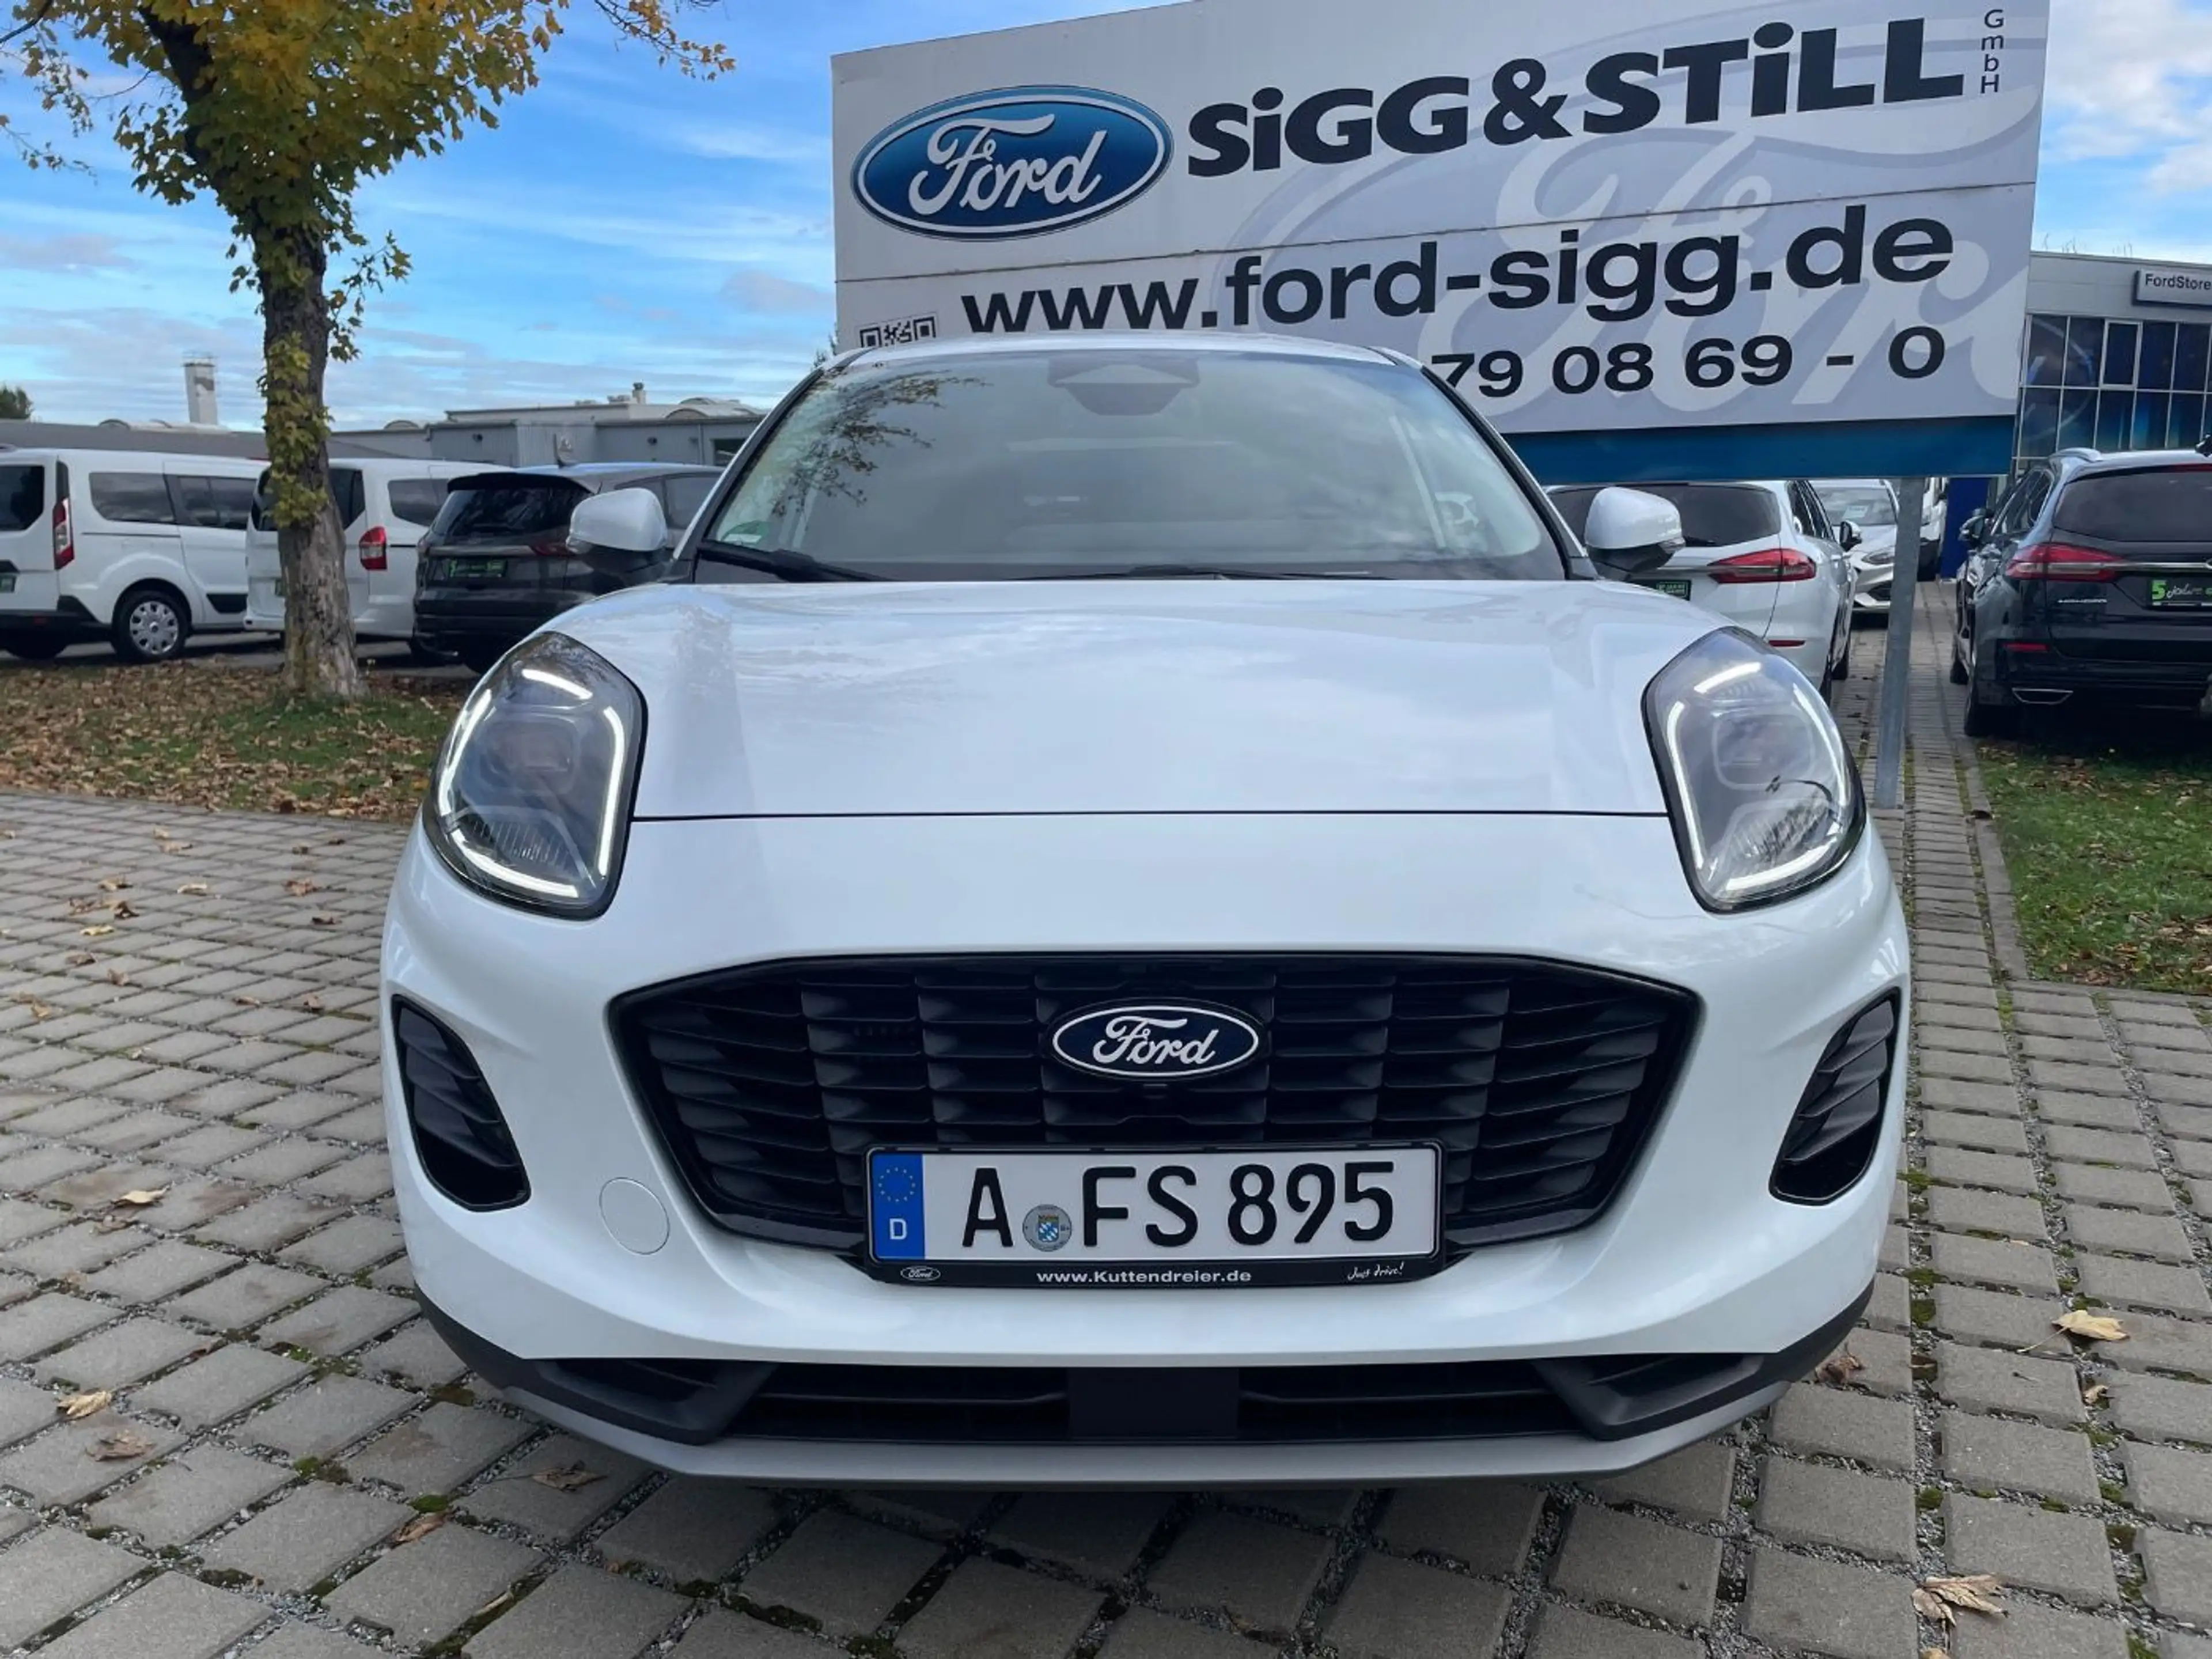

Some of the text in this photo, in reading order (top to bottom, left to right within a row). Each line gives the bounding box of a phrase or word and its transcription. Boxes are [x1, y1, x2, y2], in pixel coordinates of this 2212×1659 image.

[1980, 8, 2005, 95] GmbH
[908, 113, 1108, 216] Ford
[961, 203, 1953, 334] www.ford-sigg.de
[2145, 273, 2211, 290] FordStore
[1552, 342, 1654, 395] 08
[1684, 334, 1793, 388] 69
[1888, 325, 1945, 380] 0
[1092, 1016, 1219, 1065] Ford
[889, 1218, 907, 1240] D
[961, 1167, 1014, 1248] A
[1082, 1165, 1199, 1248] FS
[1227, 1161, 1395, 1247] 895
[1036, 1270, 1252, 1283] www.Kuttendreier.de
